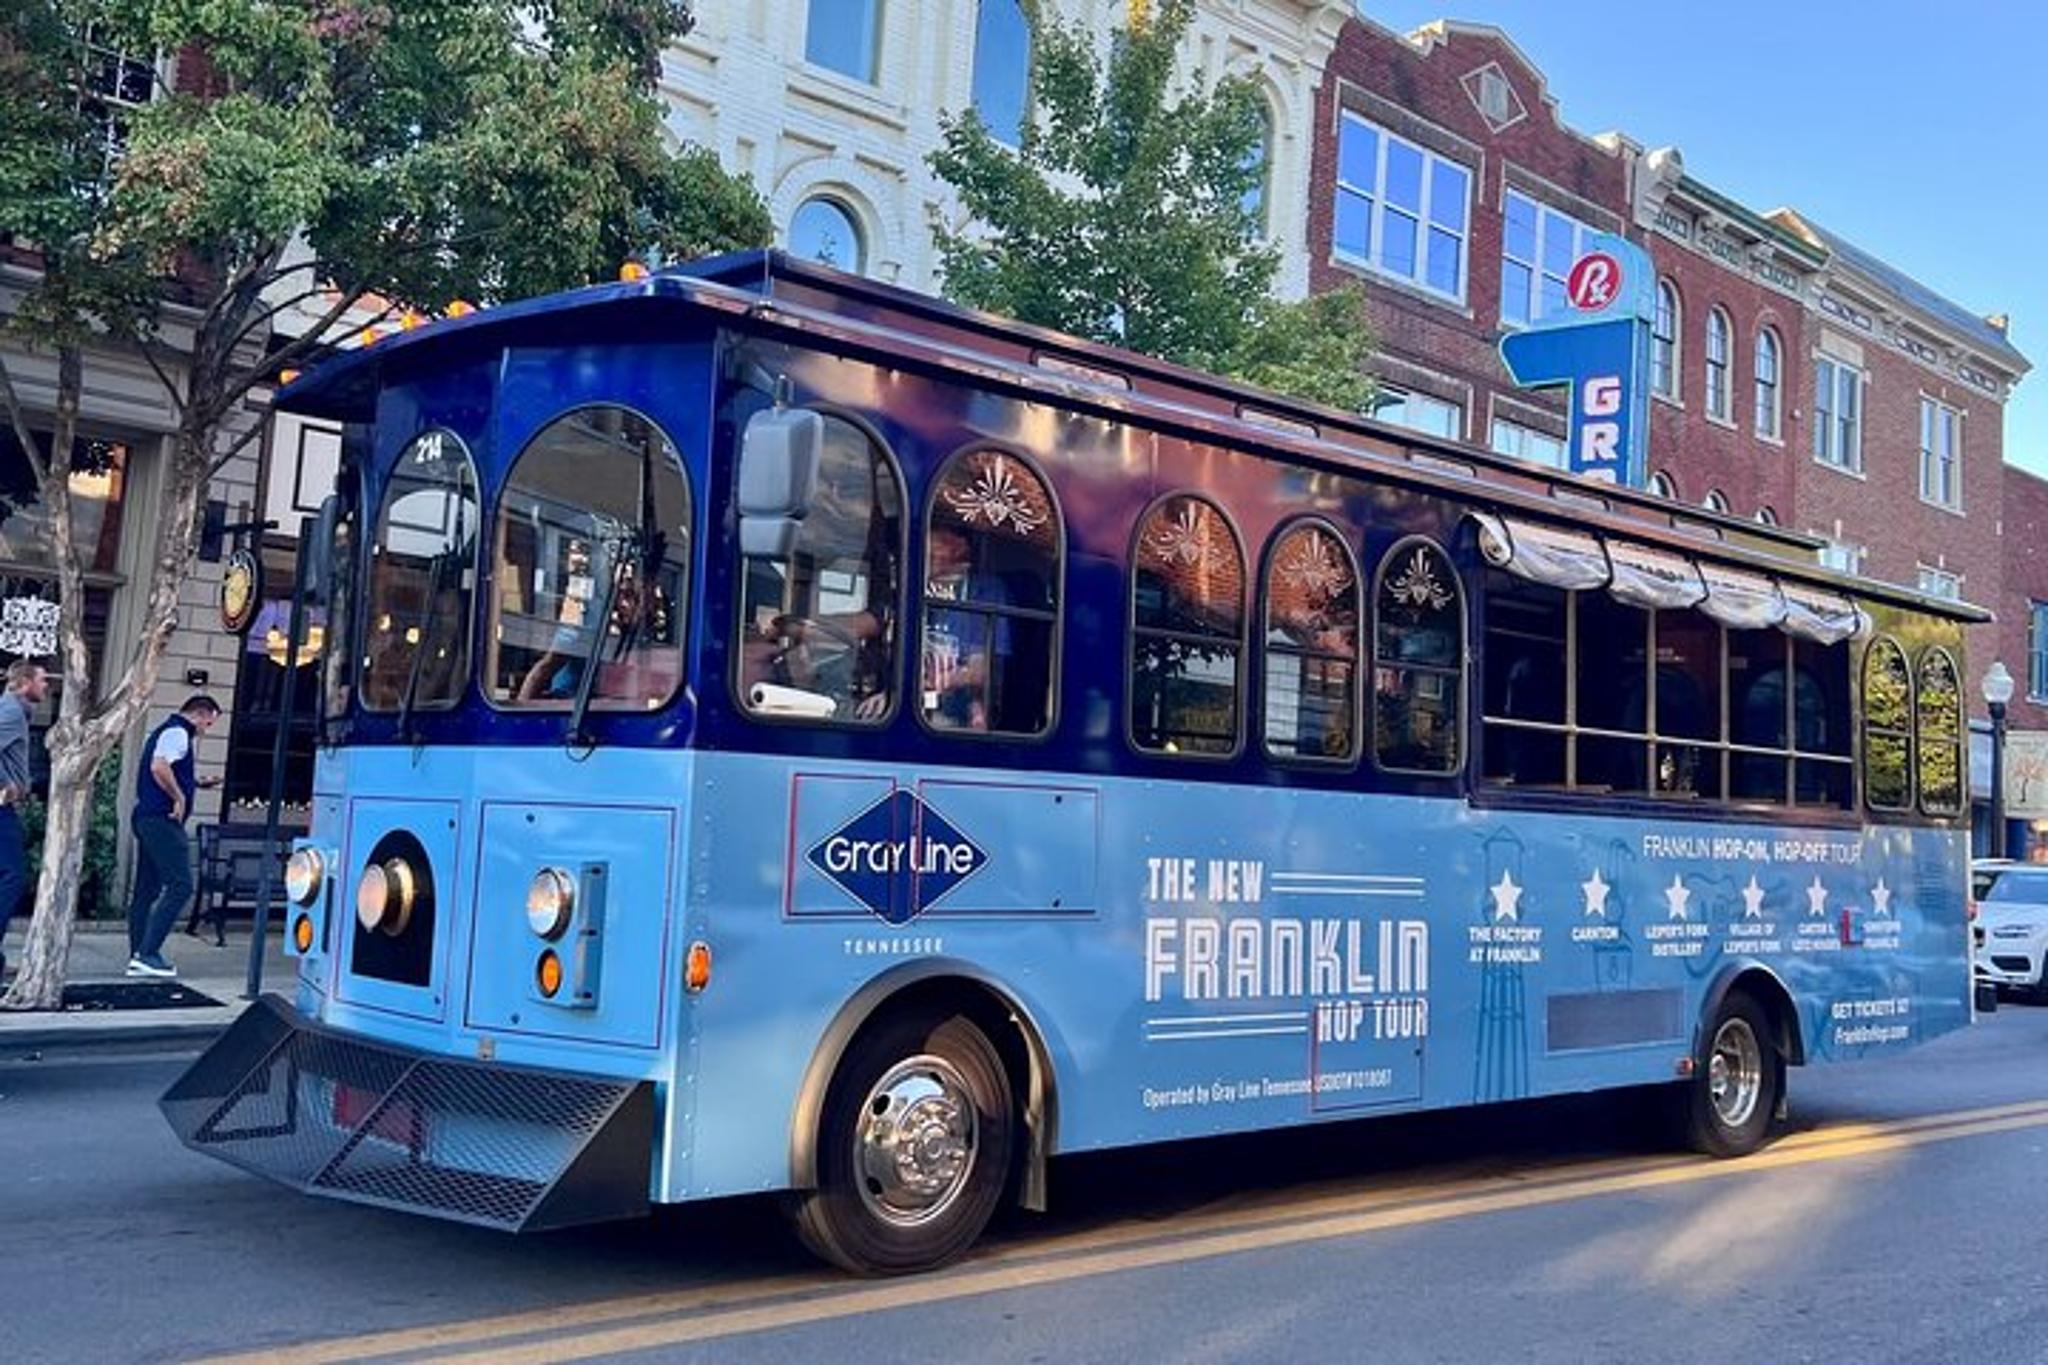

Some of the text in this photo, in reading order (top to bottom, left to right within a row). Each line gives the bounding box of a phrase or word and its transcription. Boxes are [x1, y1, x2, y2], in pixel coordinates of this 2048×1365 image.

[824, 836, 974, 874] Gray Line
[1643, 834, 1862, 864] FRANKLIN HOP-ON, HOP-OFF TOUR
[1148, 858, 1263, 902] THE NEW
[844, 938, 943, 954] TENNESSEE
[1470, 926, 1542, 942] THE FACTORY
[1145, 917, 1428, 1001] FRANKLIN
[1470, 947, 1541, 963] AT FRANKLIN
[1317, 997, 1428, 1042] HOP TOUR
[1831, 1002, 1853, 1019] GET
[1854, 999, 1896, 1017] TICKETS
[1142, 1086, 1195, 1111] Operated
[1196, 1084, 1209, 1106] by
[1211, 1080, 1235, 1103] Gray
[1237, 1081, 1260, 1099] Line
